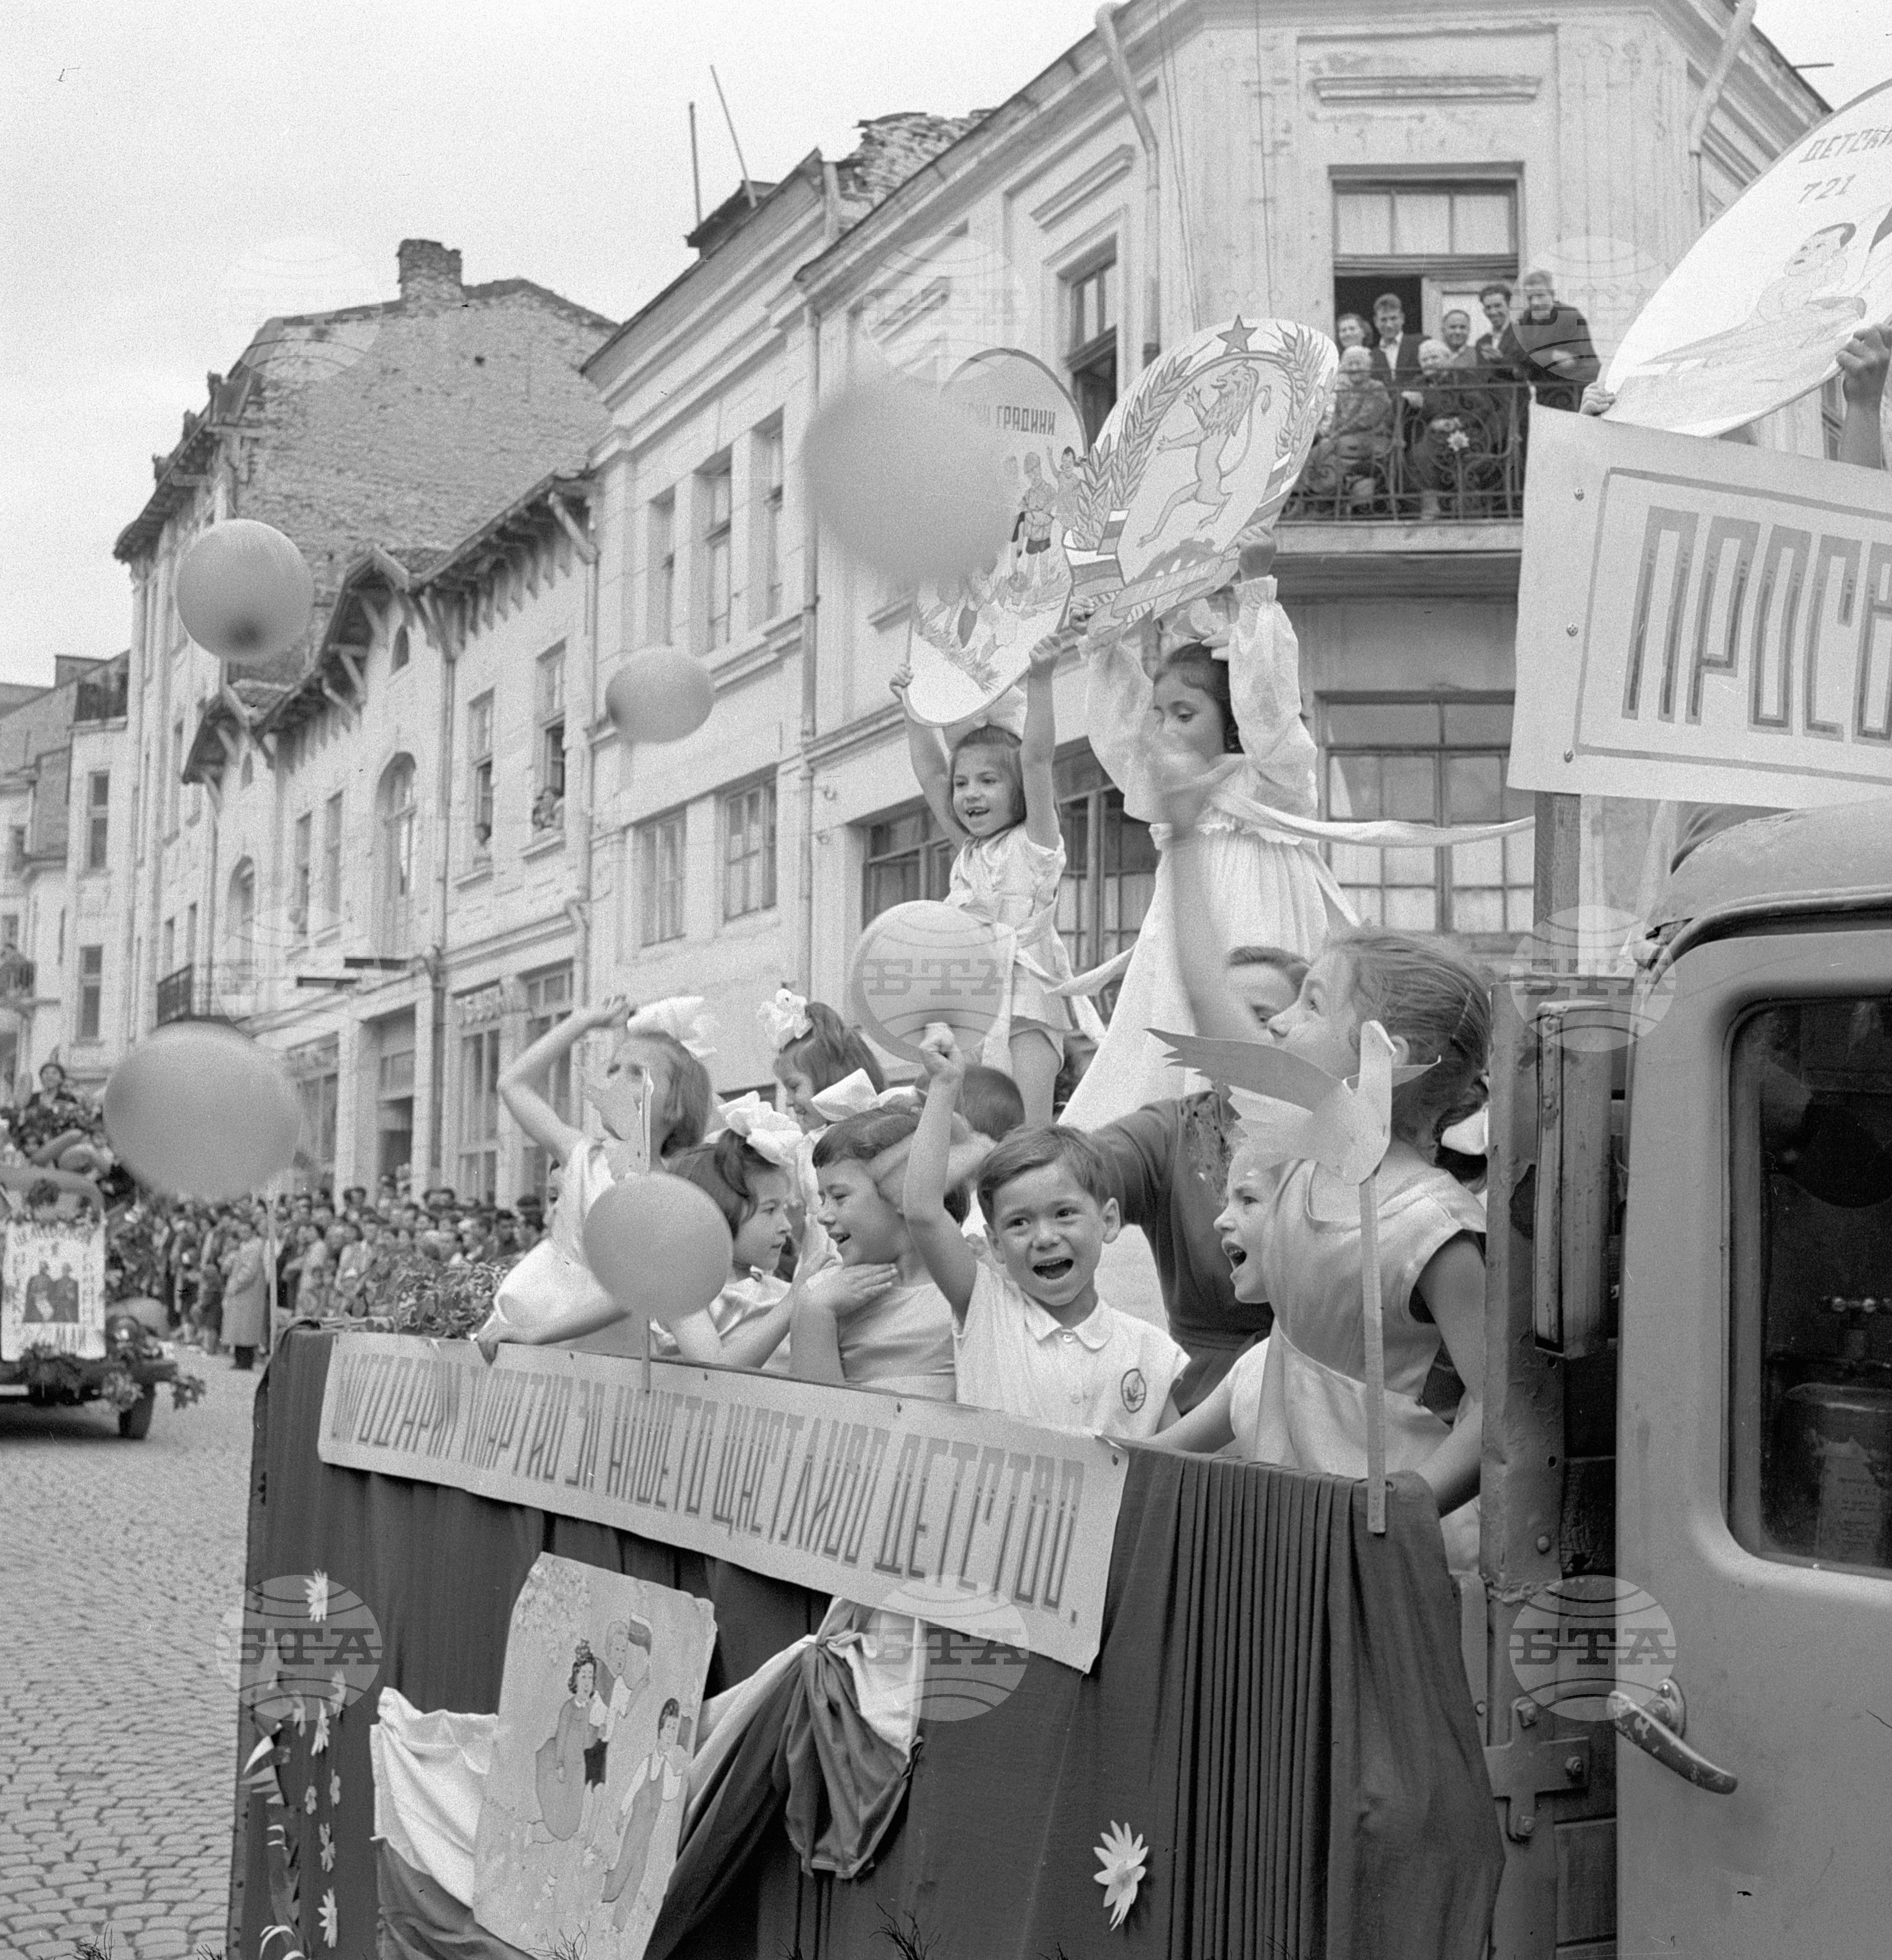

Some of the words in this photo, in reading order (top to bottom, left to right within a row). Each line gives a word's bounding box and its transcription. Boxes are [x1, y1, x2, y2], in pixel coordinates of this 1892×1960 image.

[997, 405, 1056, 436] ГРАДИНИ
[564, 1379, 606, 1491] ЗА
[605, 1385, 718, 1519] НАШЕТО
[710, 1403, 891, 1566] ЩАСТЛИВО
